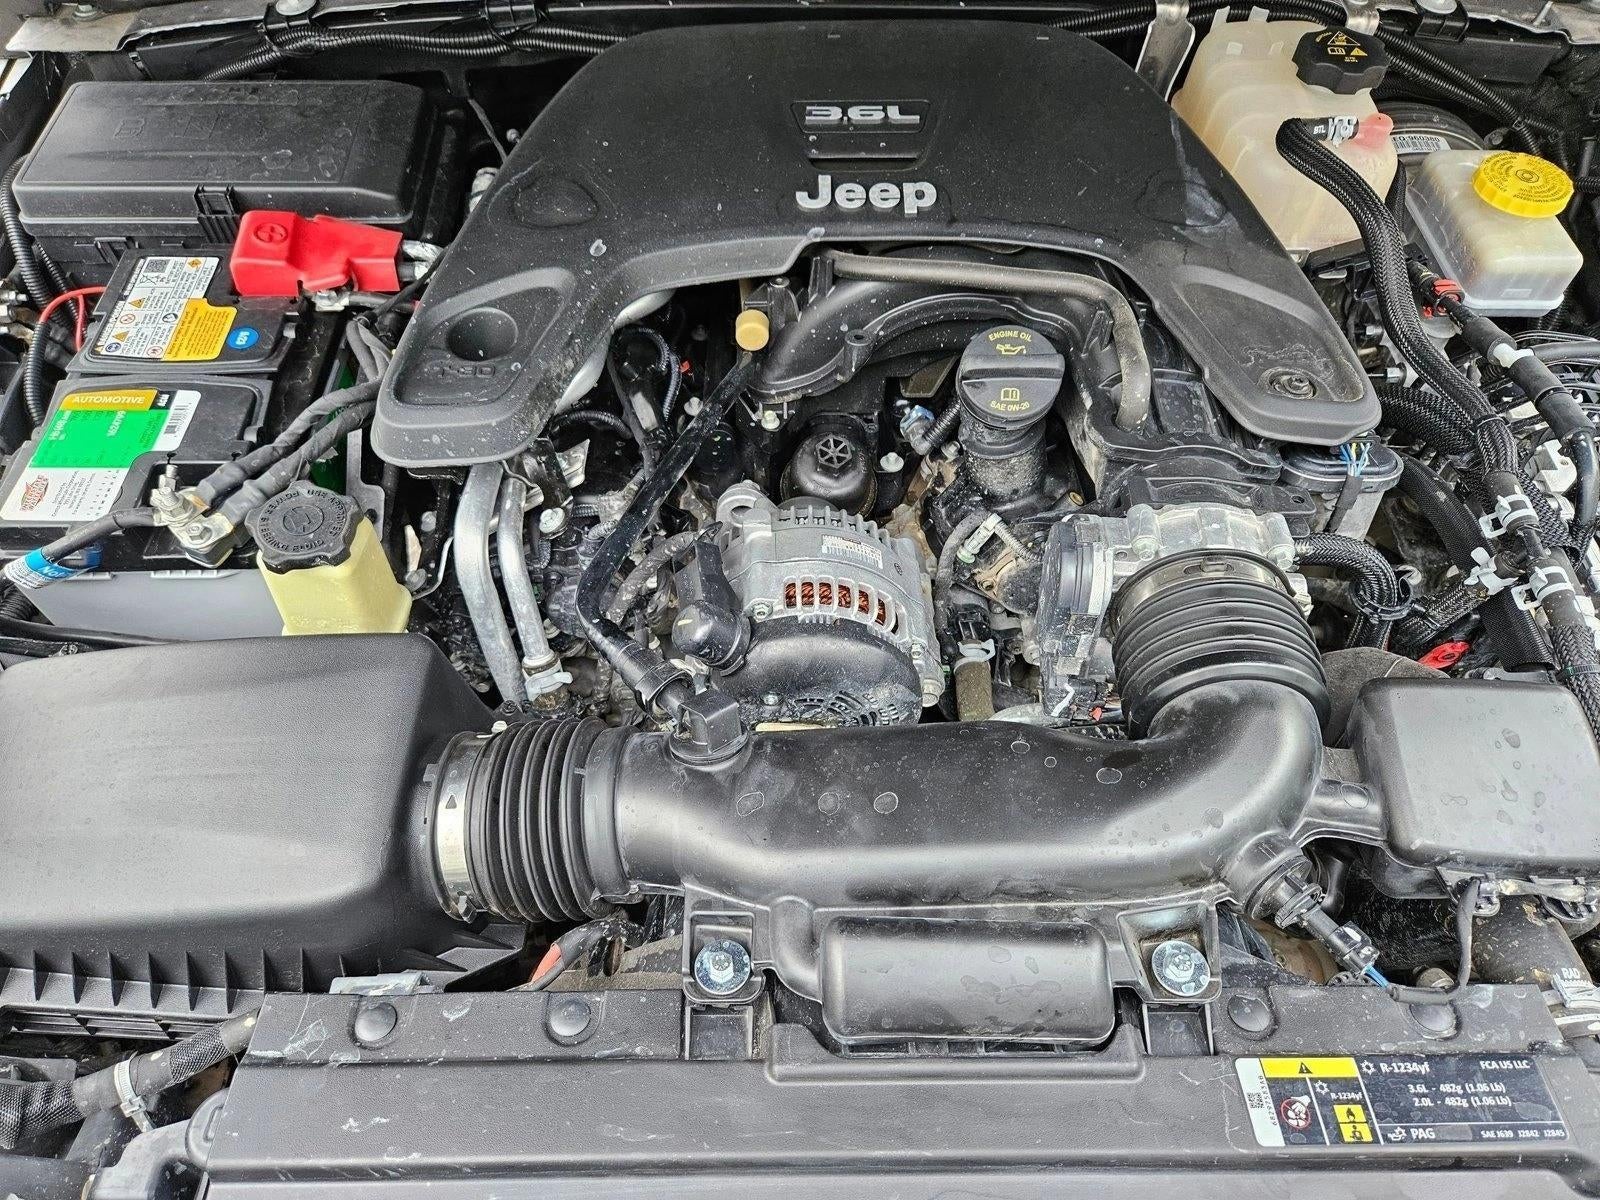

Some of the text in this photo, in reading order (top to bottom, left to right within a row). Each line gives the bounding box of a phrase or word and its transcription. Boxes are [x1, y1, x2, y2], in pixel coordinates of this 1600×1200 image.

[805, 105, 920, 124] 3.6L
[1313, 125, 1326, 134] BTL
[795, 174, 937, 217] Jeep
[988, 330, 1032, 342] ENGINE OIL
[73, 395, 146, 405] AUTOMOTIVE
[990, 400, 1030, 412] SAE 0W-20
[1561, 967, 1581, 979] RAD
[1380, 1061, 1430, 1075] R-1234yf
[1480, 1060, 1531, 1069] FCA US LLC
[1407, 1084, 1429, 1093] 3.6L
[1440, 1083, 1464, 1094] 482g
[1465, 1083, 1490, 1094] (1.06
[1489, 1083, 1506, 1093] Lb)
[1330, 1092, 1363, 1101] R-1234yf
[1412, 1097, 1434, 1107] 2.0L
[1445, 1097, 1470, 1108] 482g
[1470, 1096, 1496, 1107] (1.06
[1495, 1096, 1512, 1107] Lb)
[1410, 1128, 1436, 1140] PAG
[1480, 1130, 1496, 1138] SAE
